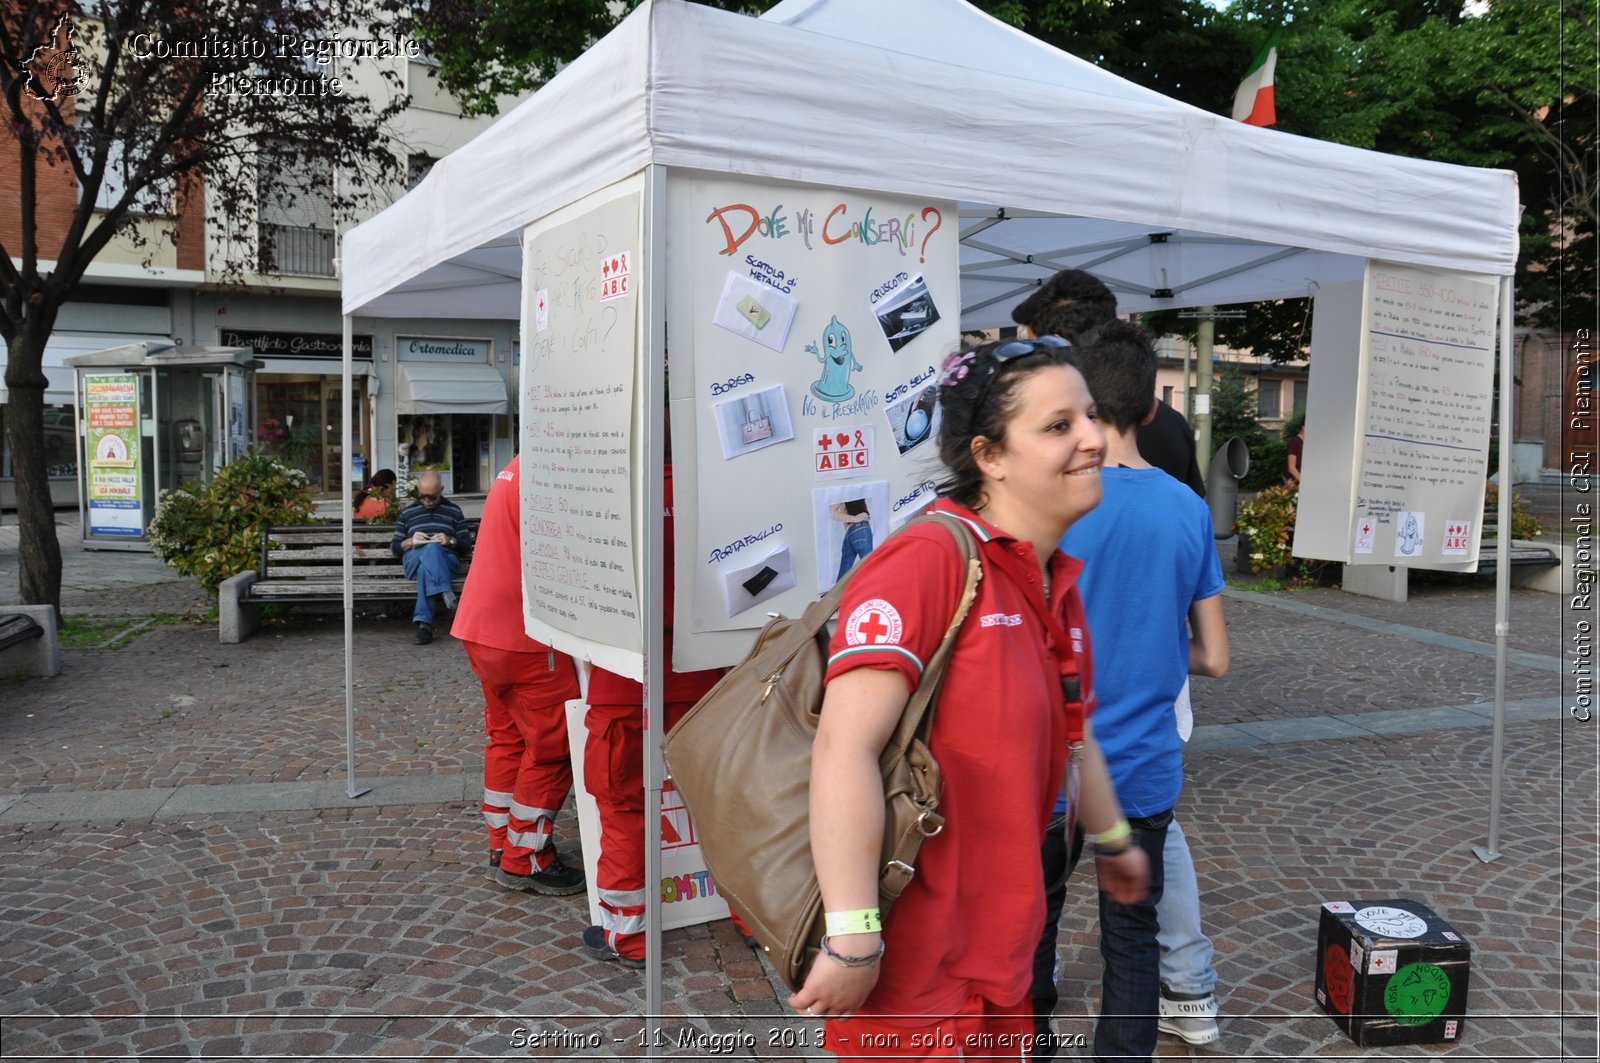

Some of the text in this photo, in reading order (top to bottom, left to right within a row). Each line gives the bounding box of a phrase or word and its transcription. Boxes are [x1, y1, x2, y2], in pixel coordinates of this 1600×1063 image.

[706, 203, 790, 256] DOVE
[745, 255, 799, 287] SCATOLA di
[750, 268, 791, 294] METALLO
[870, 271, 908, 304] CRUSCOTTO
[225, 333, 288, 352] Pastificio
[409, 340, 476, 356] Ortomedica
[710, 372, 755, 396] BORSA
[885, 365, 936, 403] SOTTO SELLA
[892, 480, 936, 512] CASSETTO
[708, 523, 783, 564] PORTAFOGLIO
